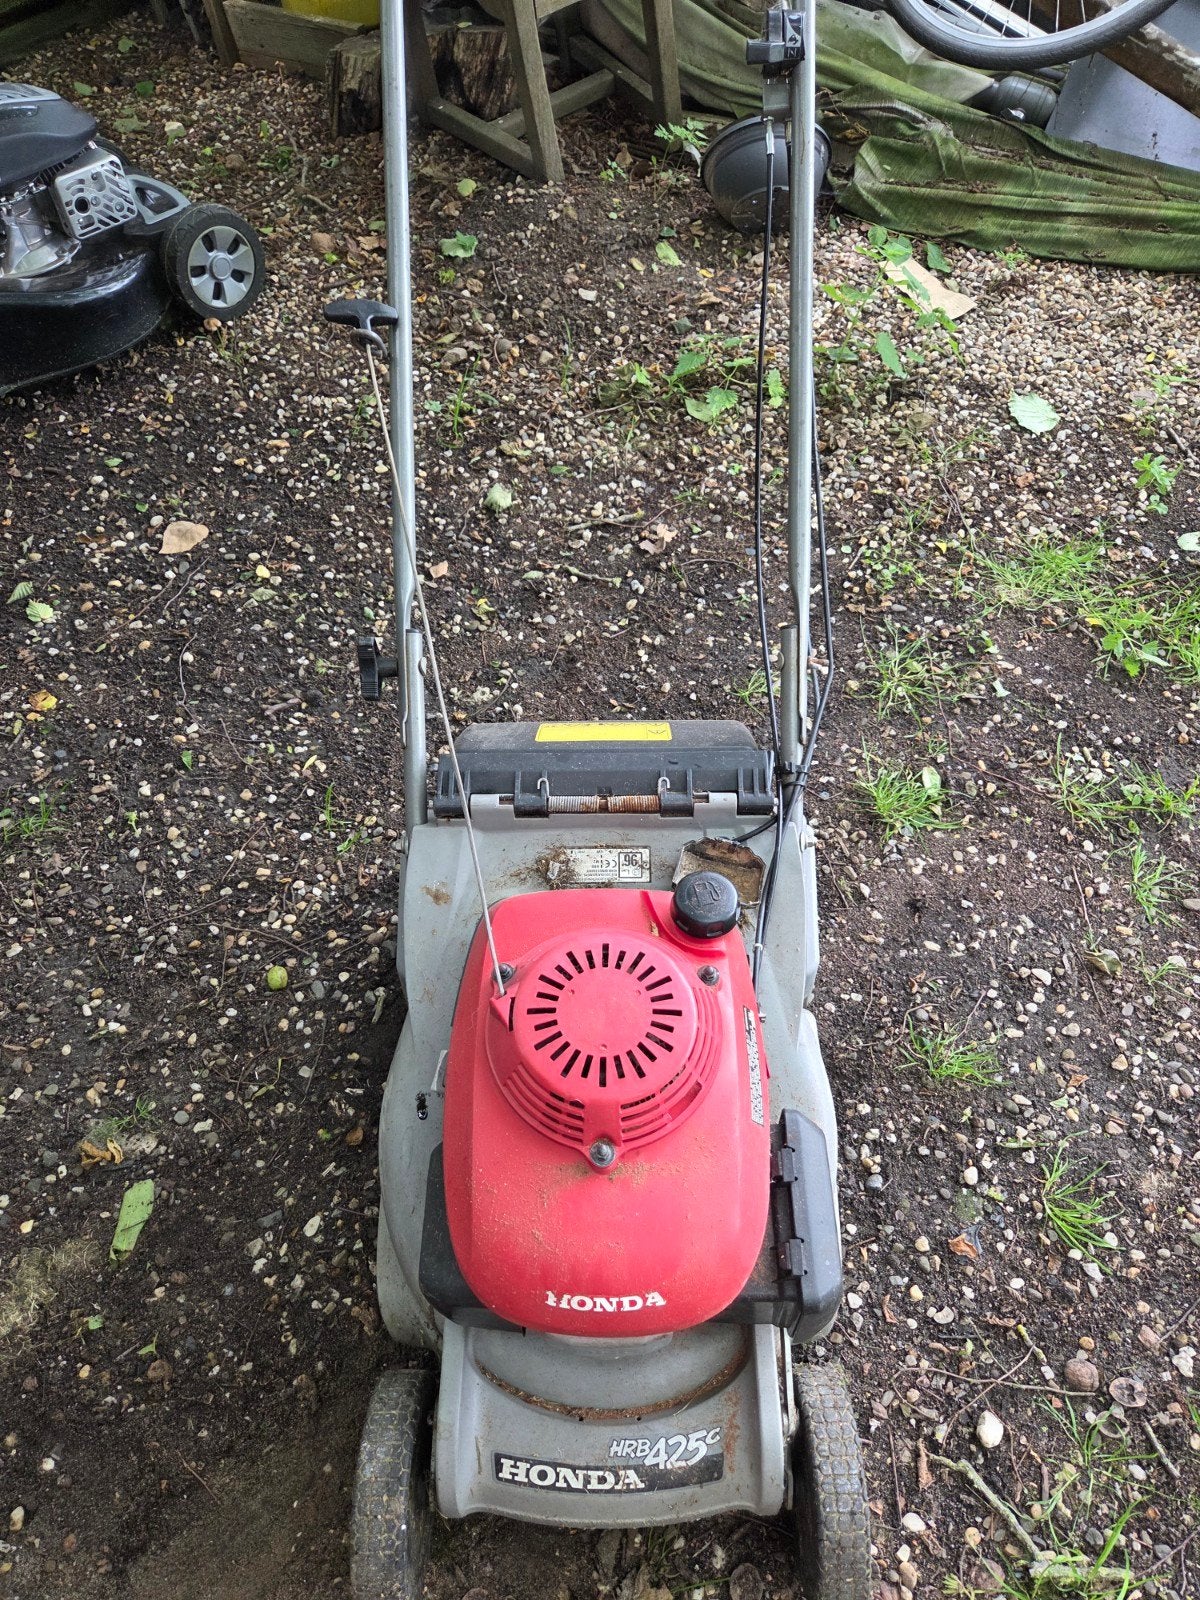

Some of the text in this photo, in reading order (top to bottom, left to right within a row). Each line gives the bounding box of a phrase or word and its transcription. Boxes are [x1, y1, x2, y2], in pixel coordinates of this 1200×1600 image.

[623, 853, 638, 867] 96
[544, 1290, 667, 1312] HONDA
[608, 1427, 722, 1470] HRB425C
[498, 1457, 646, 1490] HONDA
